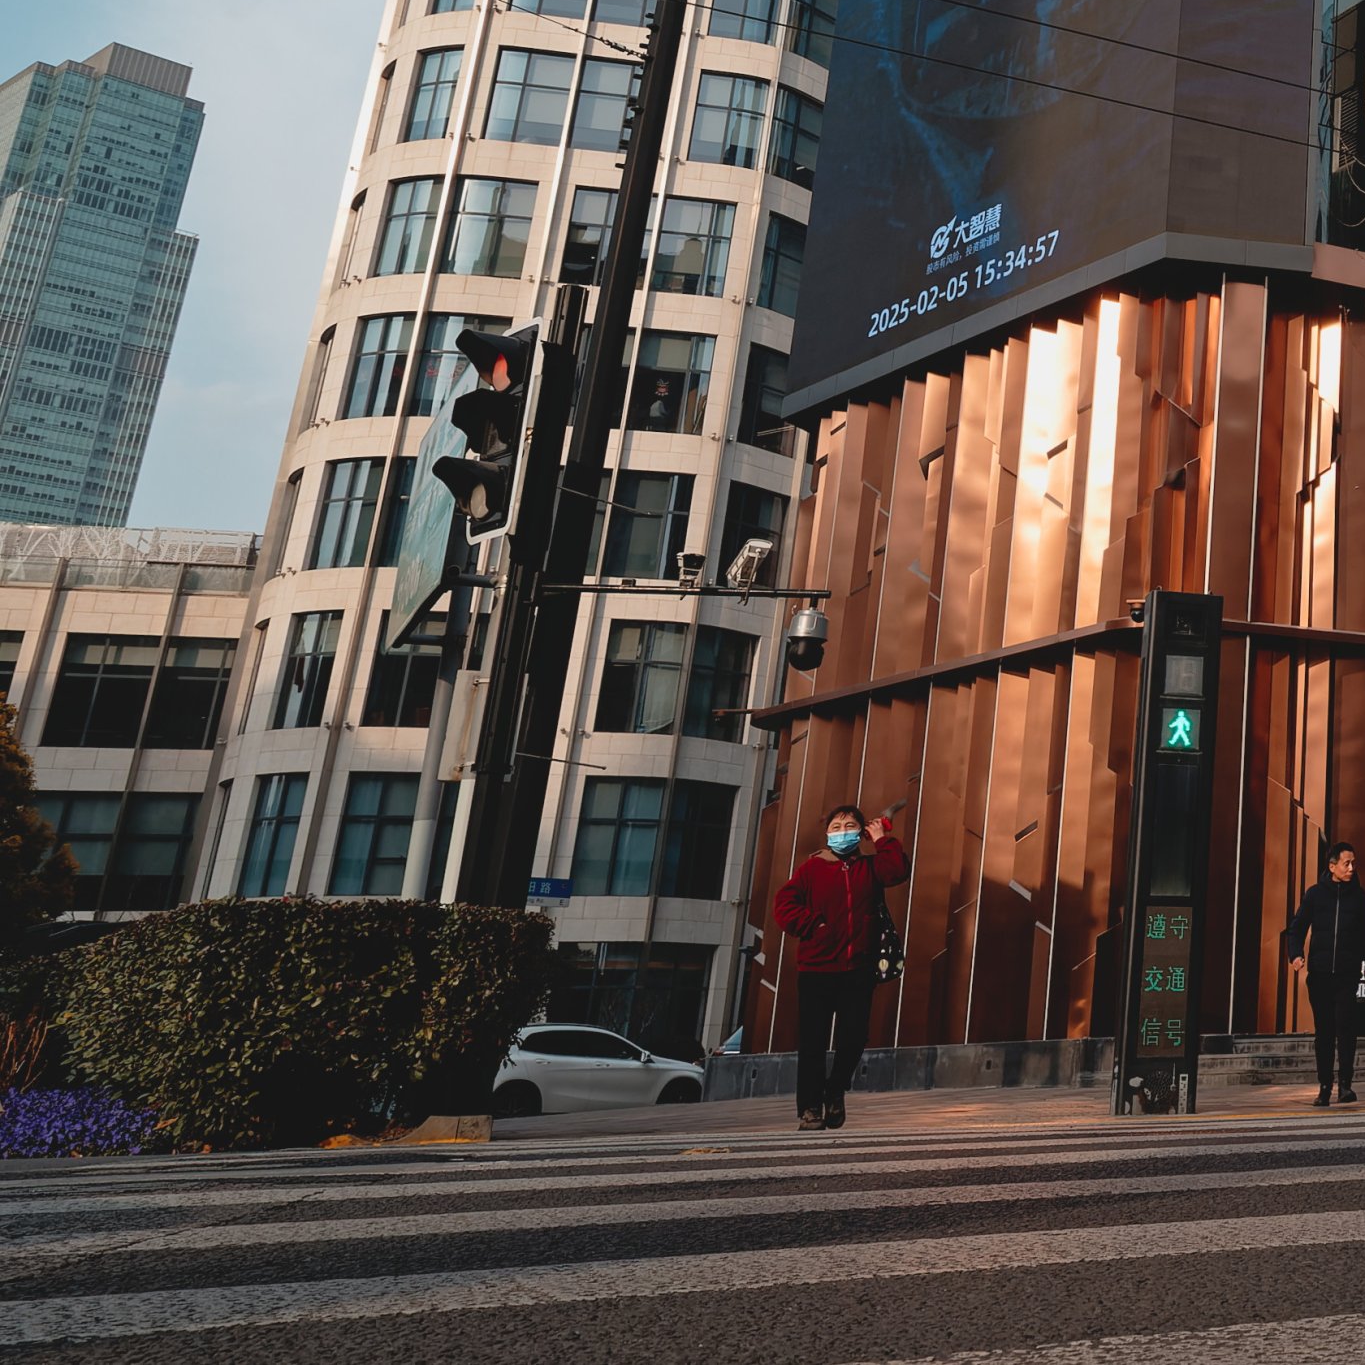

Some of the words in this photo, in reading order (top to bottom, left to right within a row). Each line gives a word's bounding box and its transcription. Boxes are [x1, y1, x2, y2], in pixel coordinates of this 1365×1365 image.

[953, 203, 1002, 249] 大智慧
[867, 270, 969, 338] 2025-02-05
[974, 229, 1060, 289] 15:34:57
[1146, 913, 1189, 940] 遵守
[1144, 966, 1186, 992] 交通
[1140, 1017, 1186, 1047] 信号
